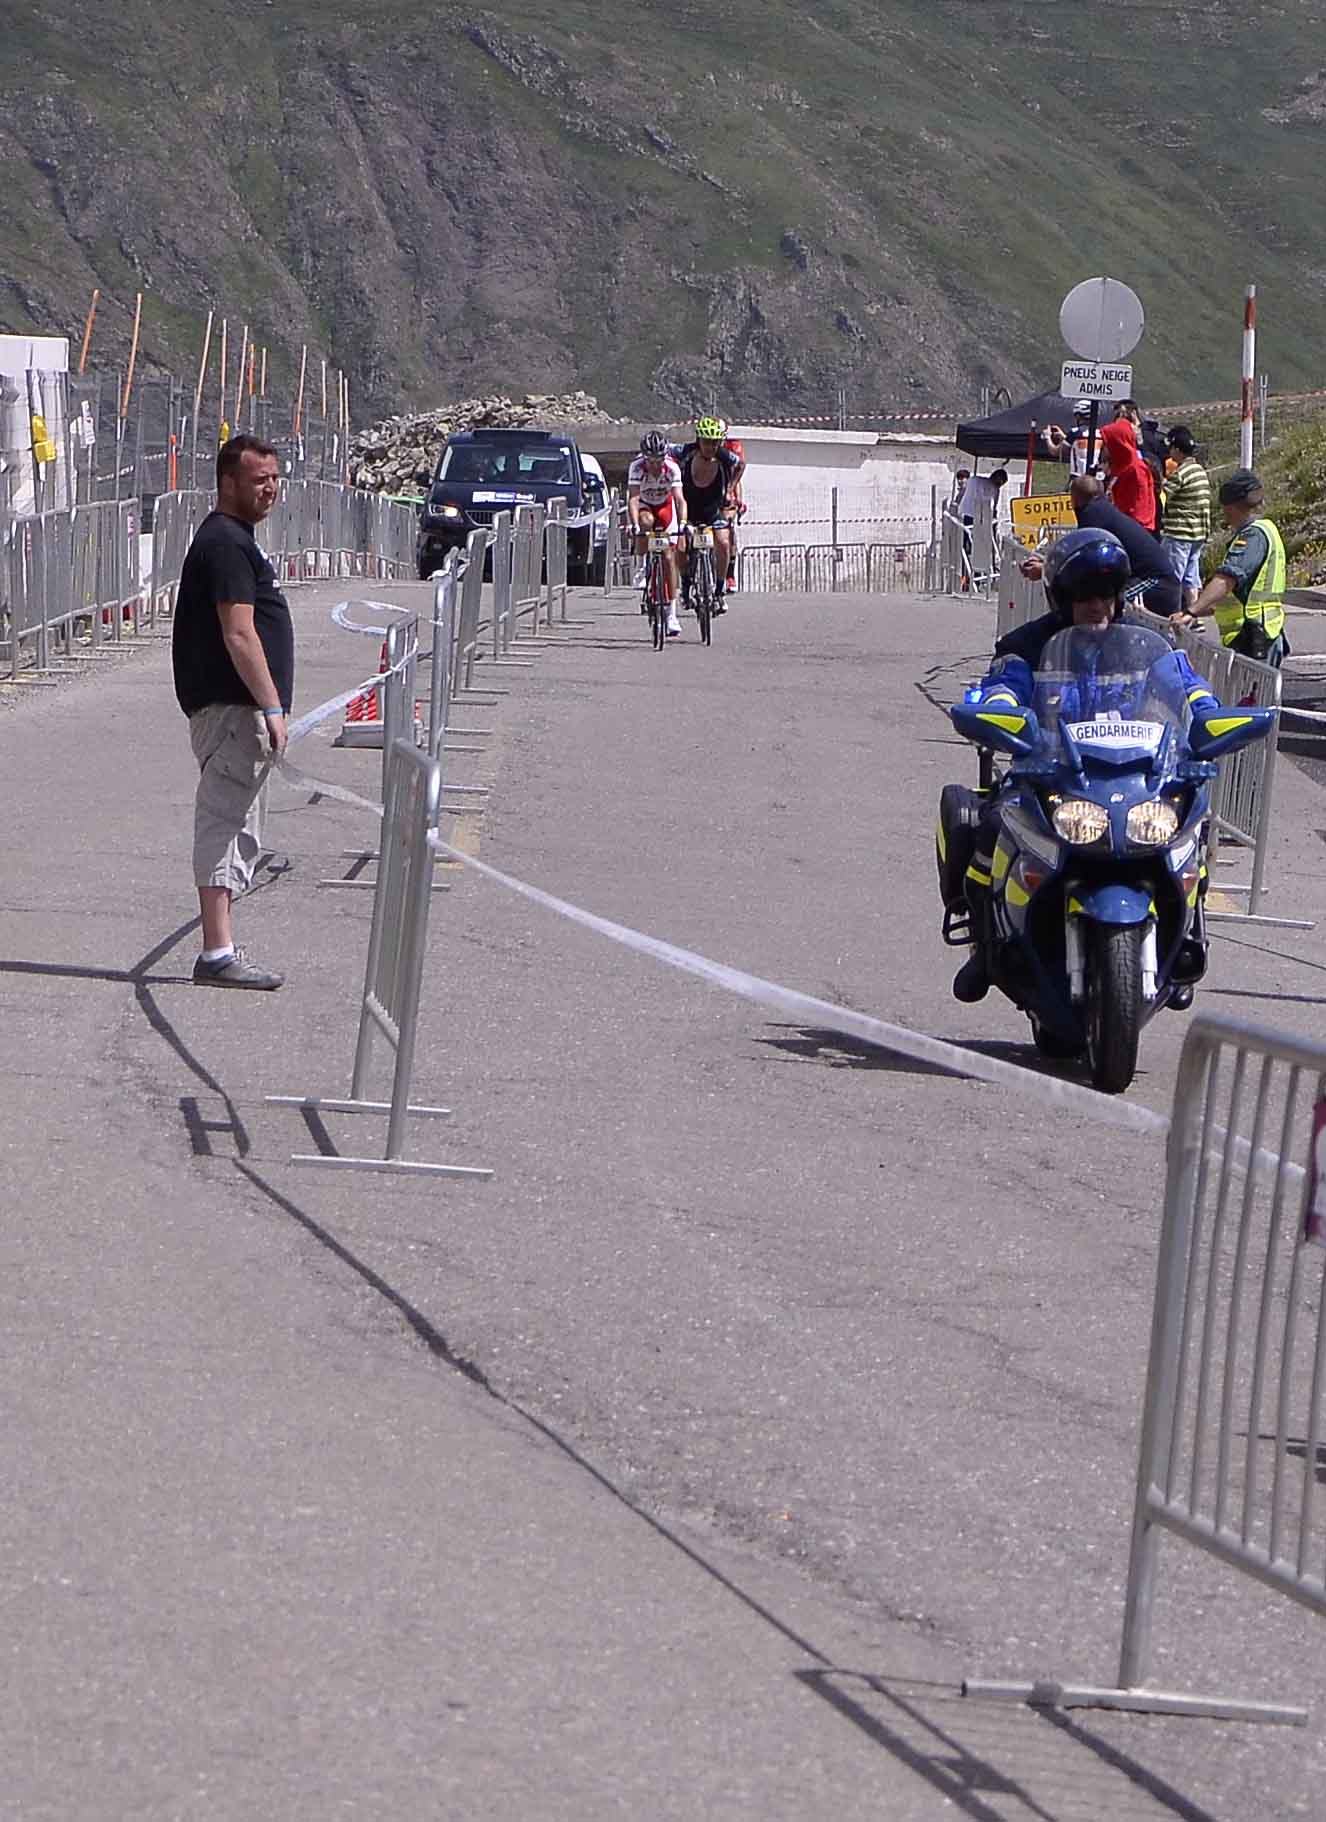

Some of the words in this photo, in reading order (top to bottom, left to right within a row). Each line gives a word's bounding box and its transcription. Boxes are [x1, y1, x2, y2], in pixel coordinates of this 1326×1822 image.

[1063, 366, 1097, 380] PNEUS
[1101, 369, 1131, 383] NEIGE
[1079, 382, 1113, 396] ADMIS
[1024, 500, 1073, 514] SORTIE
[1076, 724, 1153, 740] GENDARMERIE
